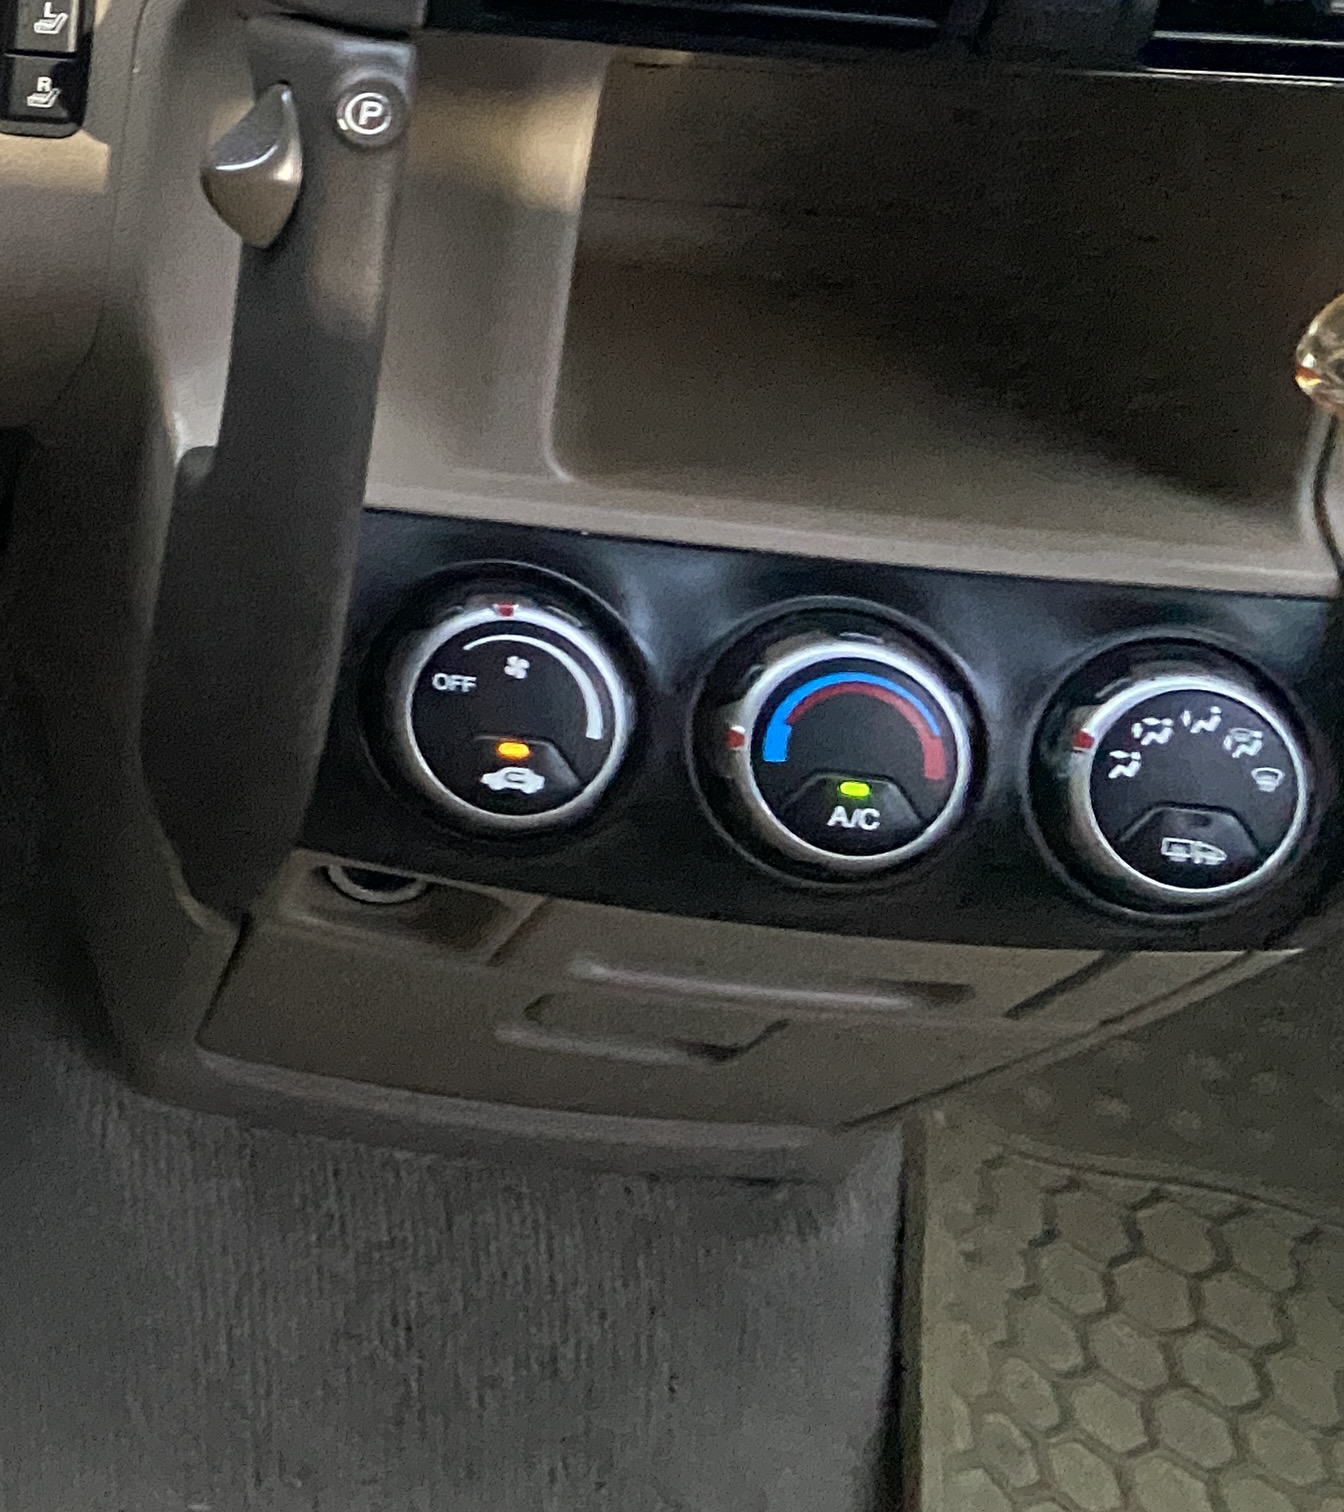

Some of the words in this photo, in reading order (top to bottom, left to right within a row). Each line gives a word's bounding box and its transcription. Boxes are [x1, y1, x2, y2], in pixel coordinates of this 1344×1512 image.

[358, 101, 384, 125] P
[432, 672, 478, 693] OFF
[826, 805, 881, 831] A/C
